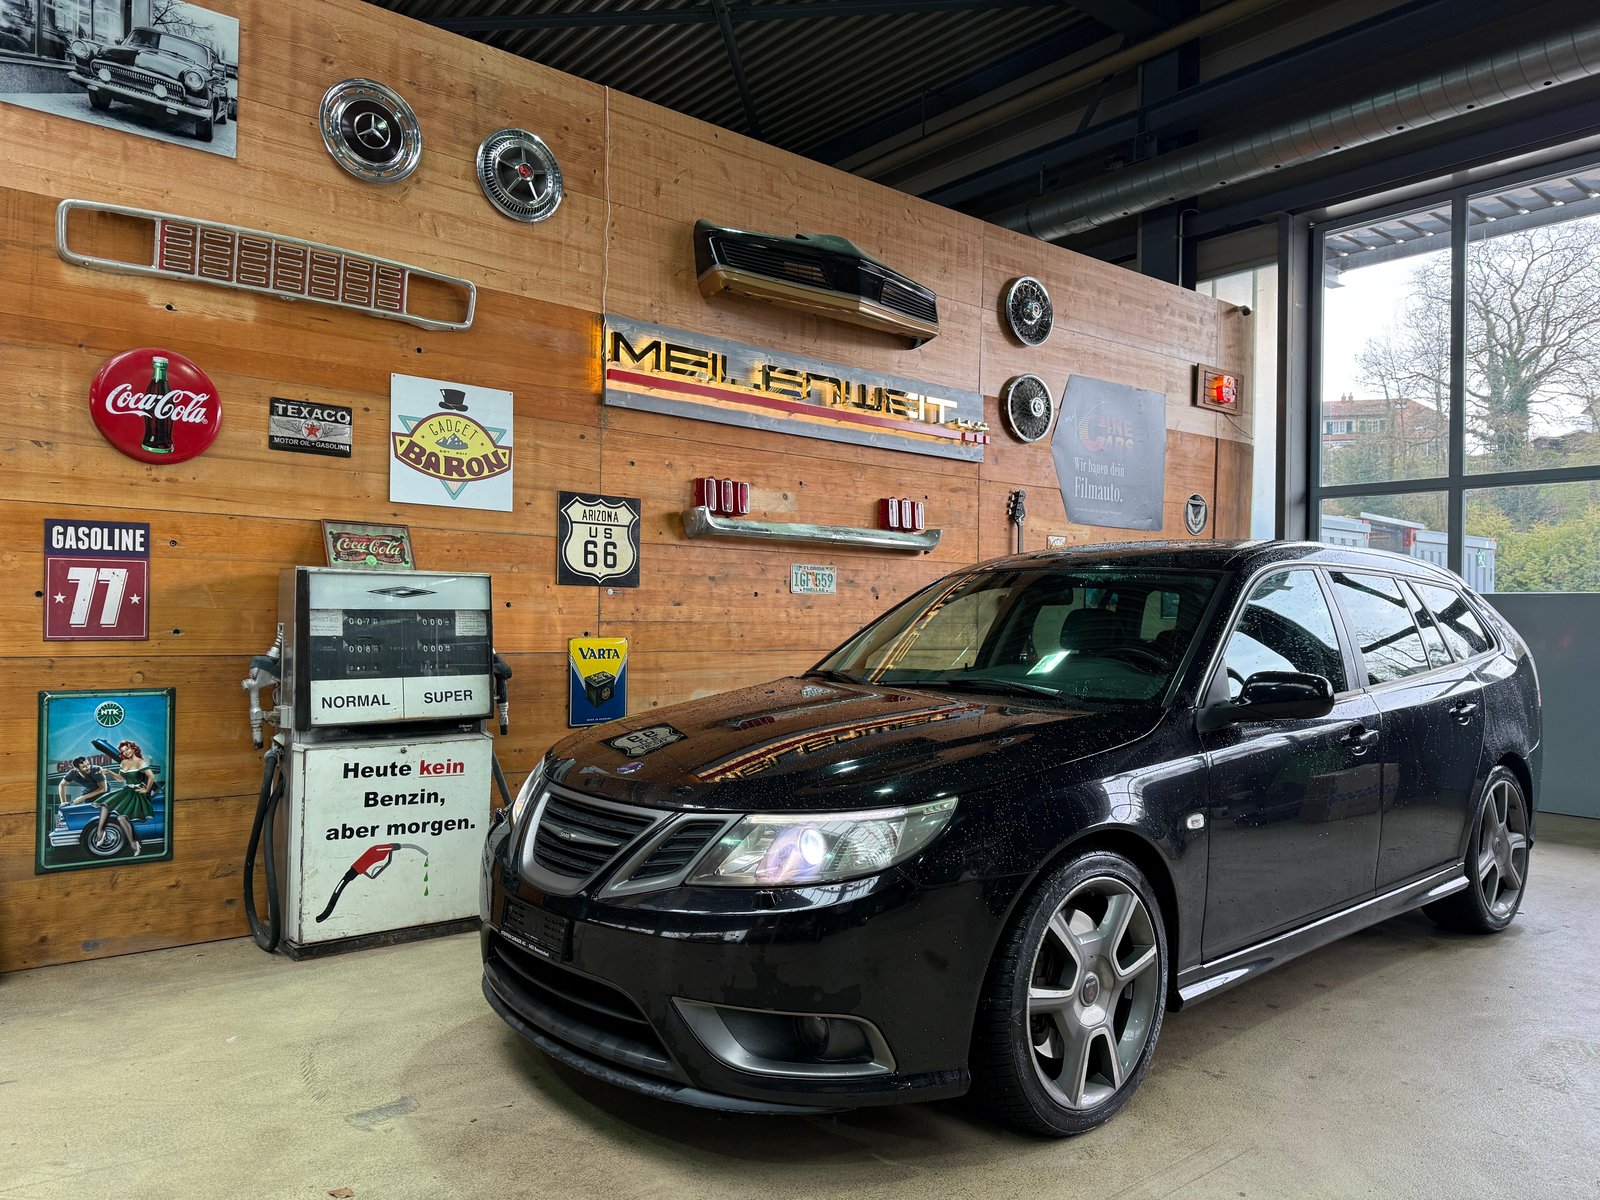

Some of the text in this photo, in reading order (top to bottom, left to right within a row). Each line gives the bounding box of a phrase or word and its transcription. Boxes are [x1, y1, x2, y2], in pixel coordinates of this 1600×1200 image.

[105, 383, 210, 424] Coca-Cola
[274, 403, 350, 424] TEXACO
[428, 419, 479, 440] GADGET
[273, 436, 299, 446] MOTOR
[400, 439, 508, 478] BARON
[1074, 456, 1125, 478] Wir bauen dein
[1074, 476, 1123, 503] Filmauto.
[581, 509, 620, 523] ARIZONA
[51, 525, 146, 552] GASOLINE
[583, 540, 618, 569] 66
[67, 566, 129, 628] 77
[578, 646, 621, 660] VARTA
[321, 689, 473, 709] NORMAL SUPER
[100, 708, 120, 716] NTK
[342, 759, 466, 779] Heute kein
[364, 789, 446, 808] Benzin,
[325, 817, 476, 841] aber morgen.
